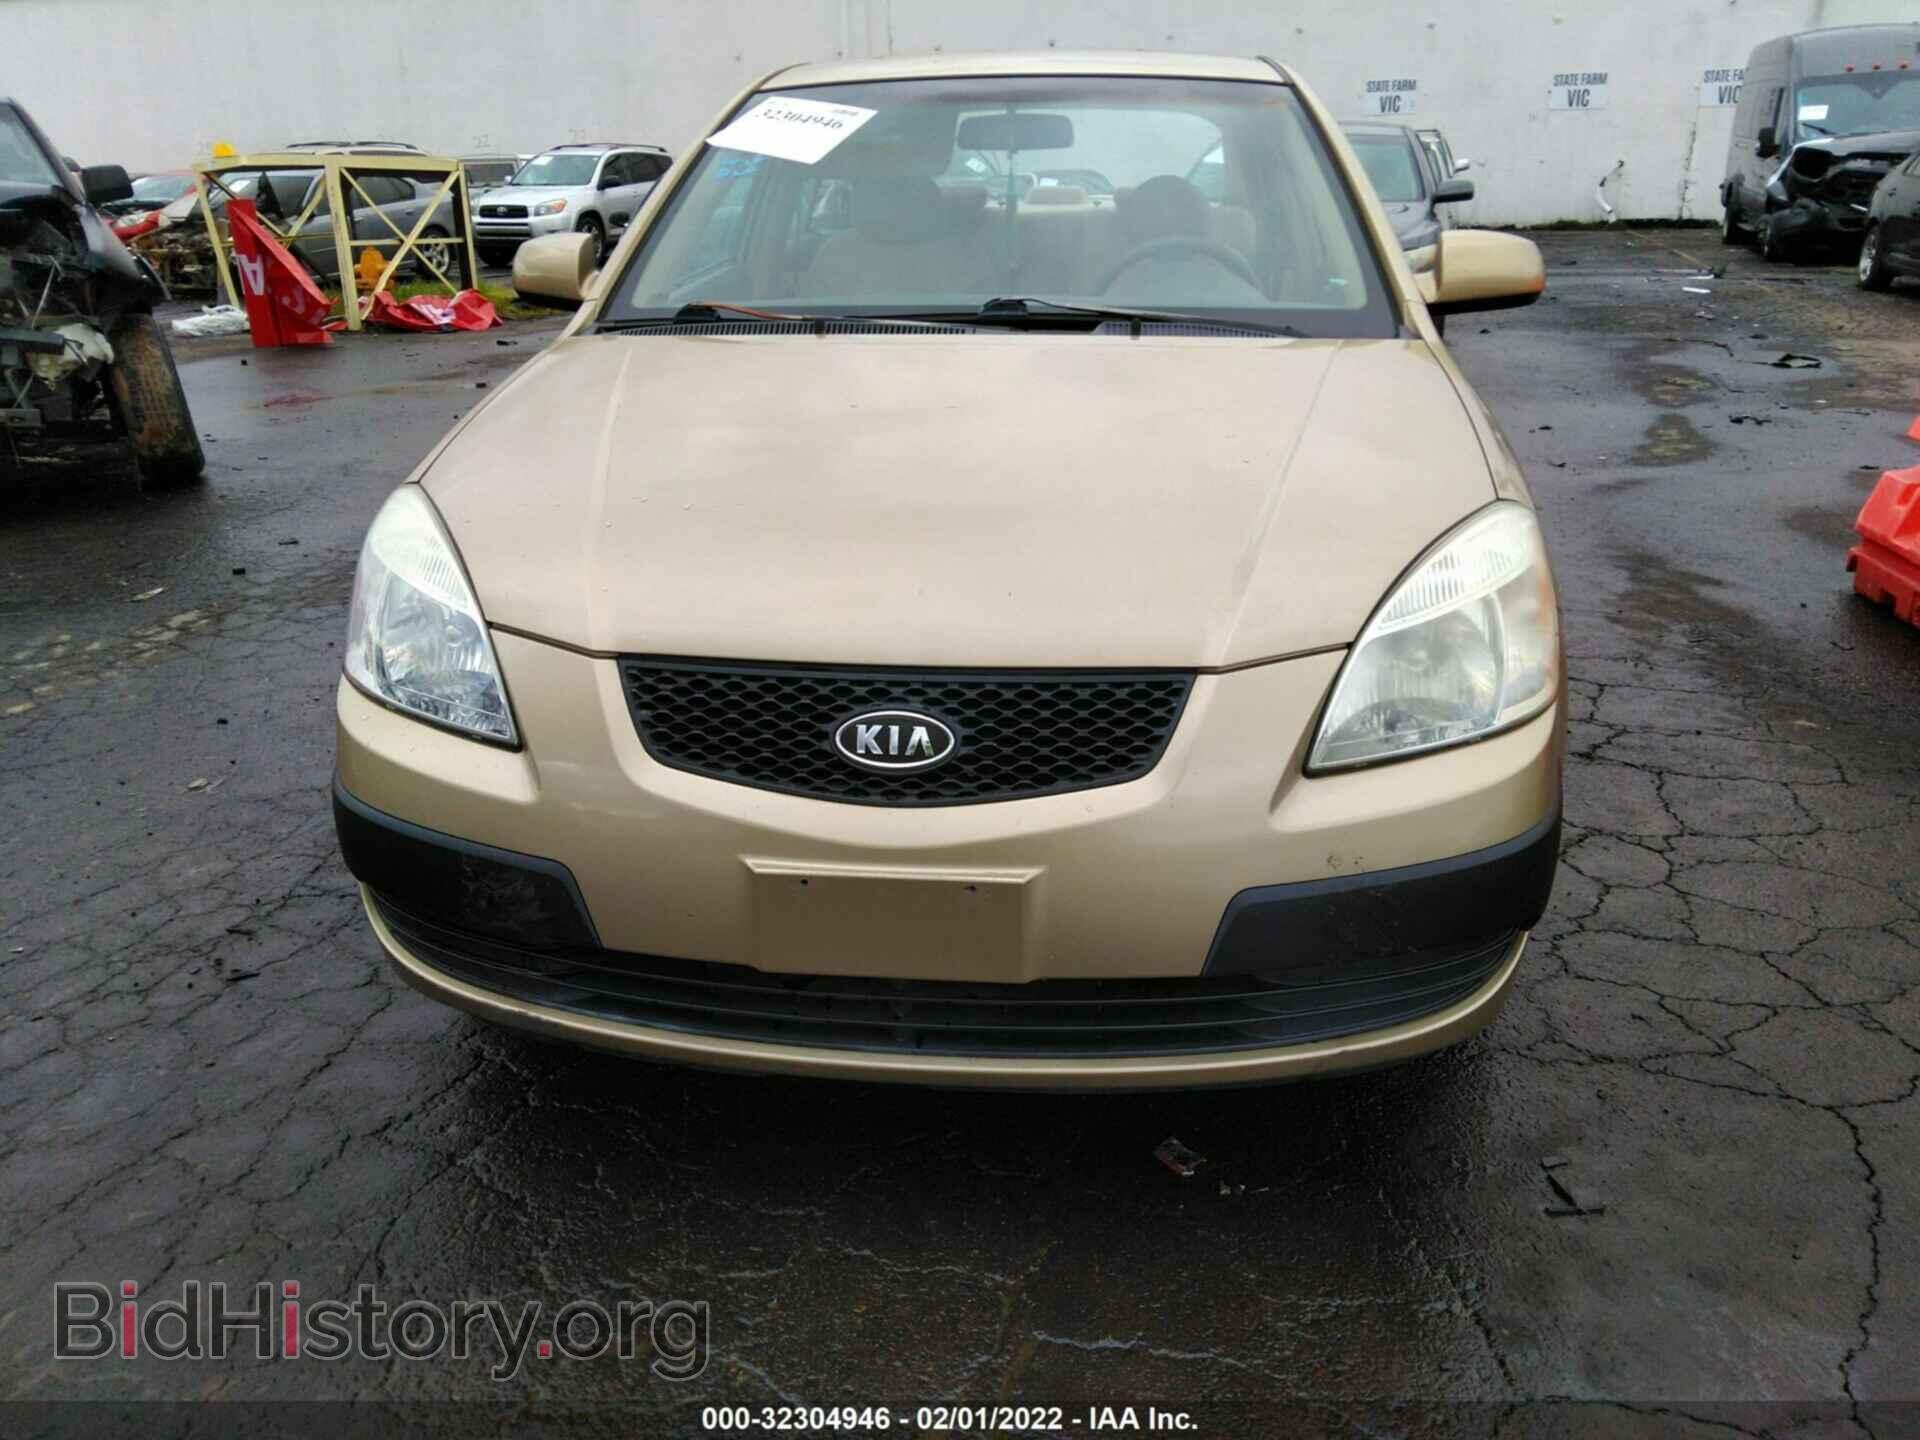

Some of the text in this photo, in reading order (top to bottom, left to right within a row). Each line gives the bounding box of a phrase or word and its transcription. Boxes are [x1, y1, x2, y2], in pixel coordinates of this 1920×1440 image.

[1553, 73, 1608, 87] STATE FARM
[1703, 69, 1744, 83] STATE FA
[1366, 79, 1417, 93] STATE FARM
[1379, 95, 1402, 113] VIC
[1567, 88, 1591, 107] VIC
[855, 724, 935, 756] KIA
